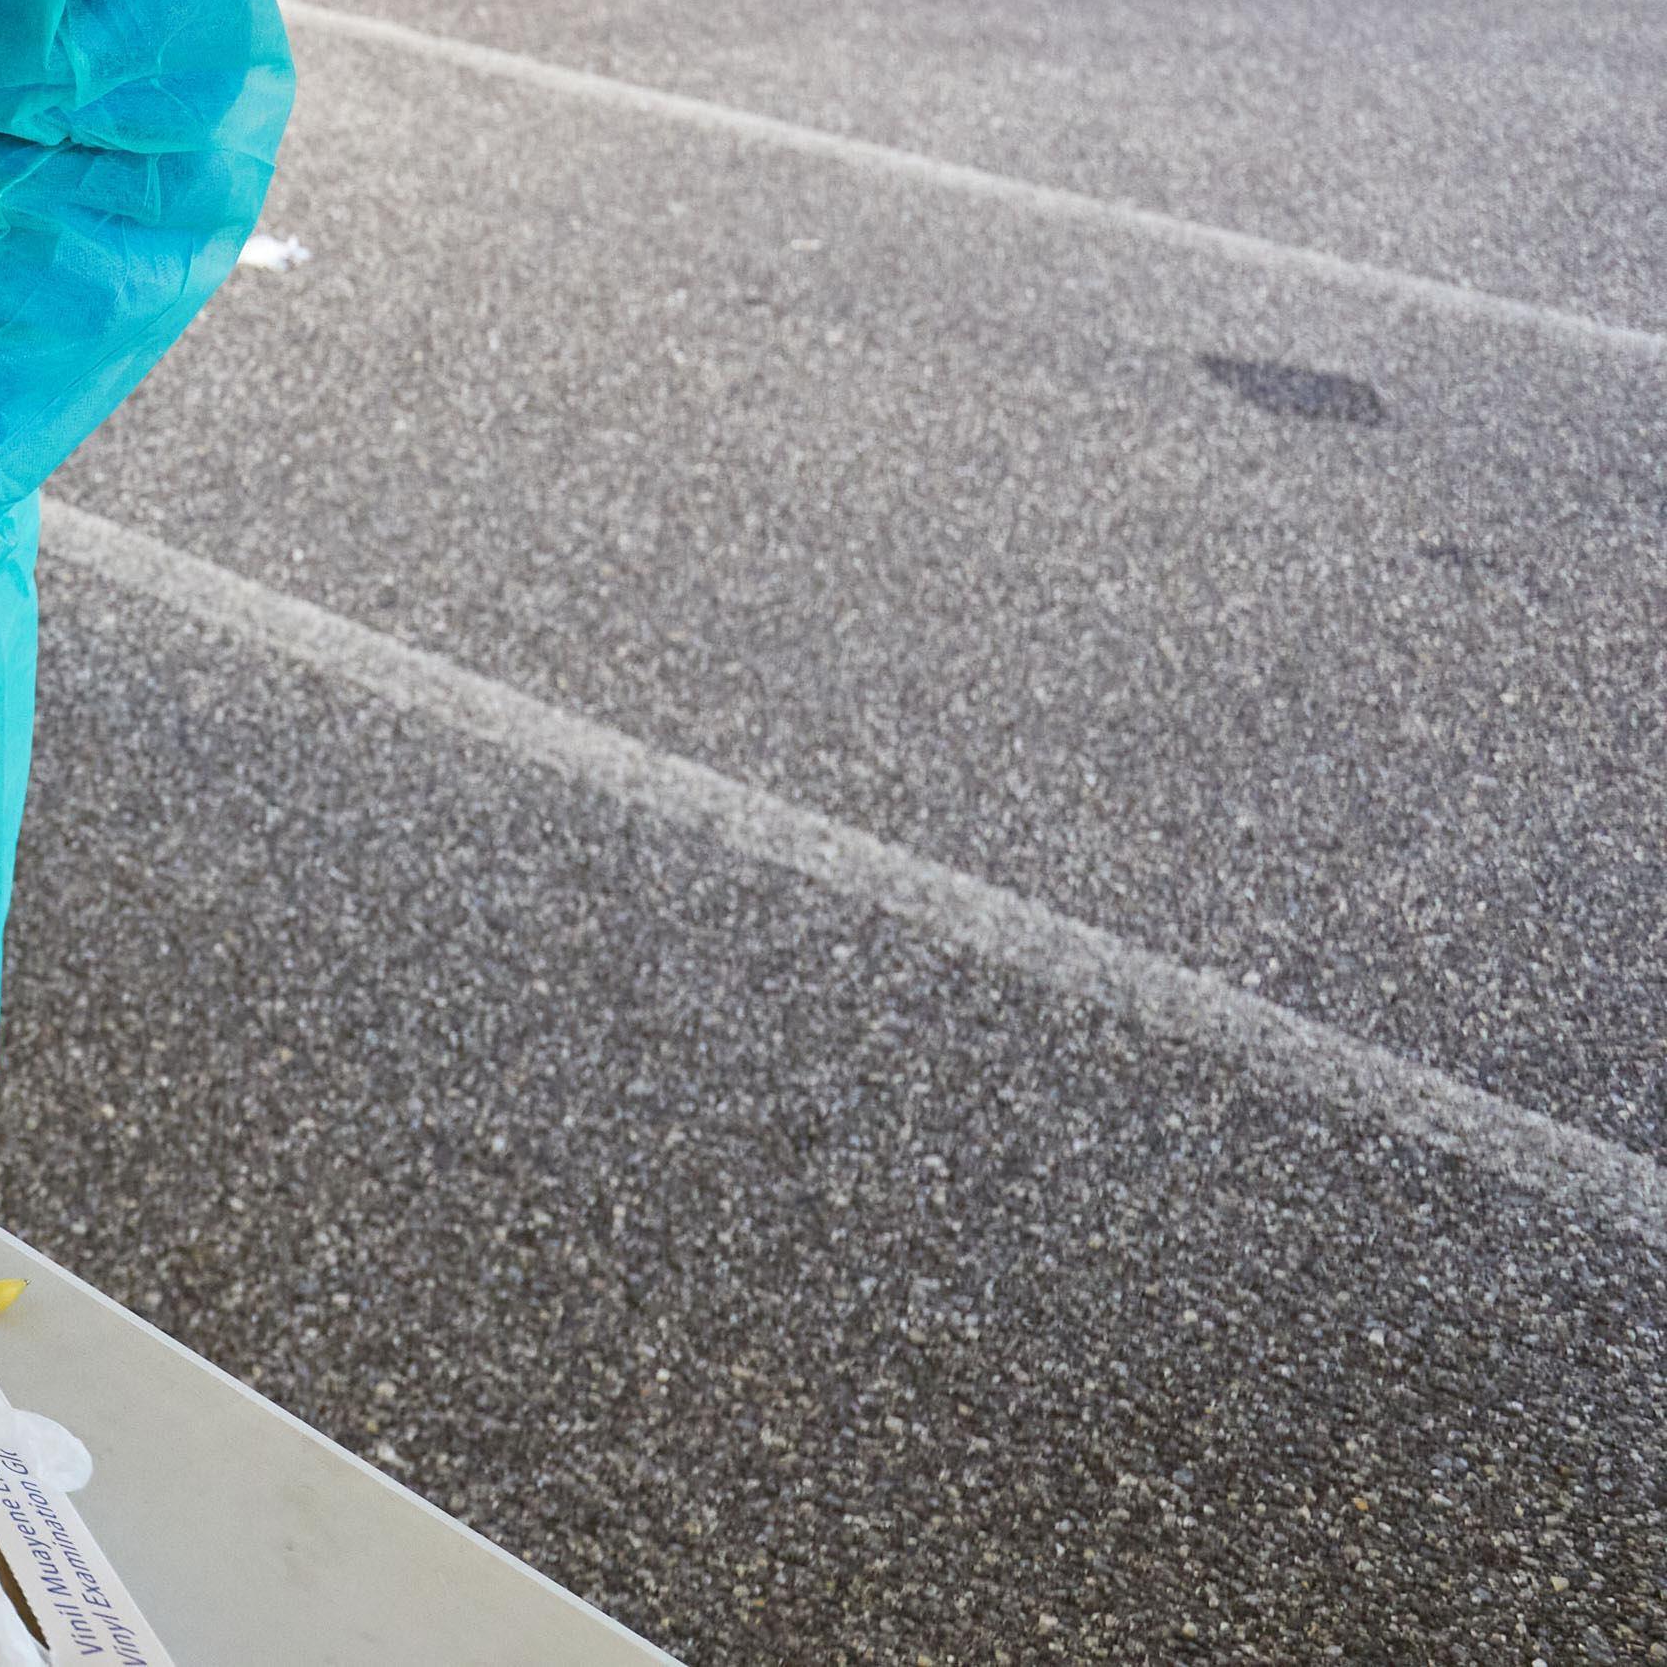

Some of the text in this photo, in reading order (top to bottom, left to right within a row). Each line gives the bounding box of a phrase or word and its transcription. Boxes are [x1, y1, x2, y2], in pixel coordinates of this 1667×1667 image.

[2, 1498, 71, 1597] Muayene
[20, 1480, 112, 1610] Examination
[54, 1602, 104, 1656] Vinil
[92, 1612, 148, 1667] Vinyl
